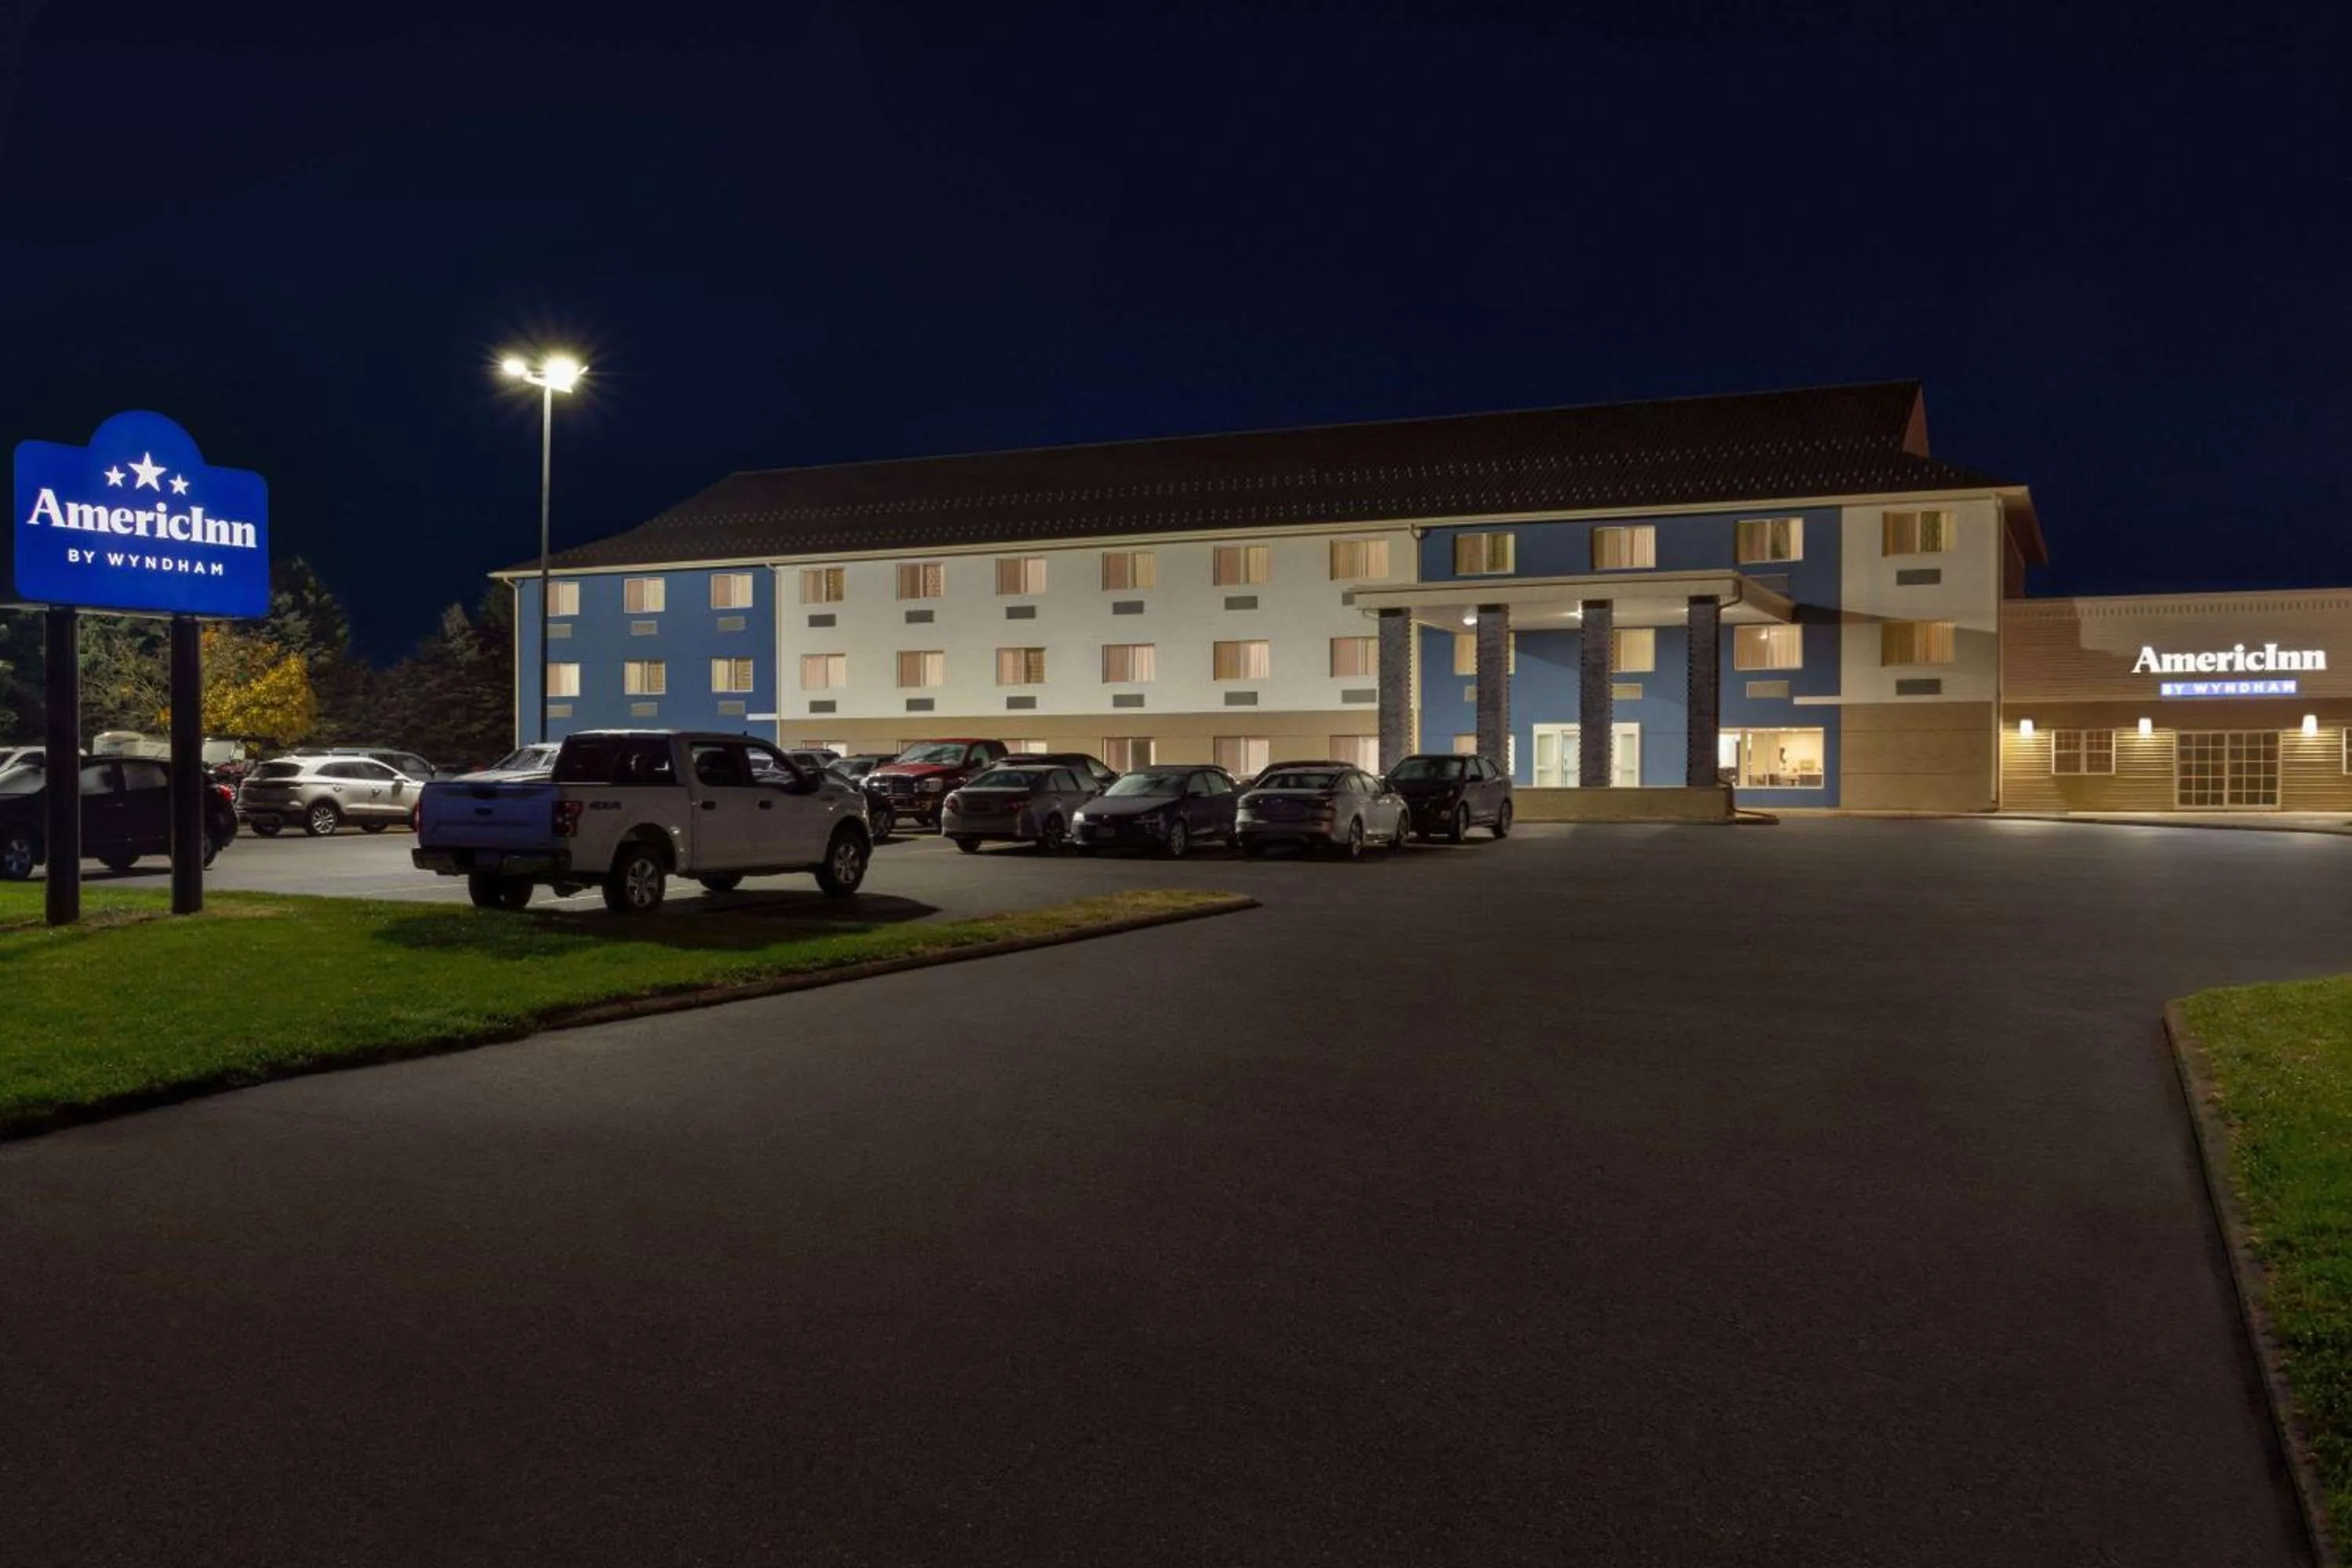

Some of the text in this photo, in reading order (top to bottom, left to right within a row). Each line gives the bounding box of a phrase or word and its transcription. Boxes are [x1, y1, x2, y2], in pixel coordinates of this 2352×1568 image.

[27, 488, 257, 548] AmericInn
[68, 549, 224, 576] BY WYNDHAM
[2132, 643, 2327, 673] AmericInn
[2161, 681, 2296, 695] BY WYNDHAM
